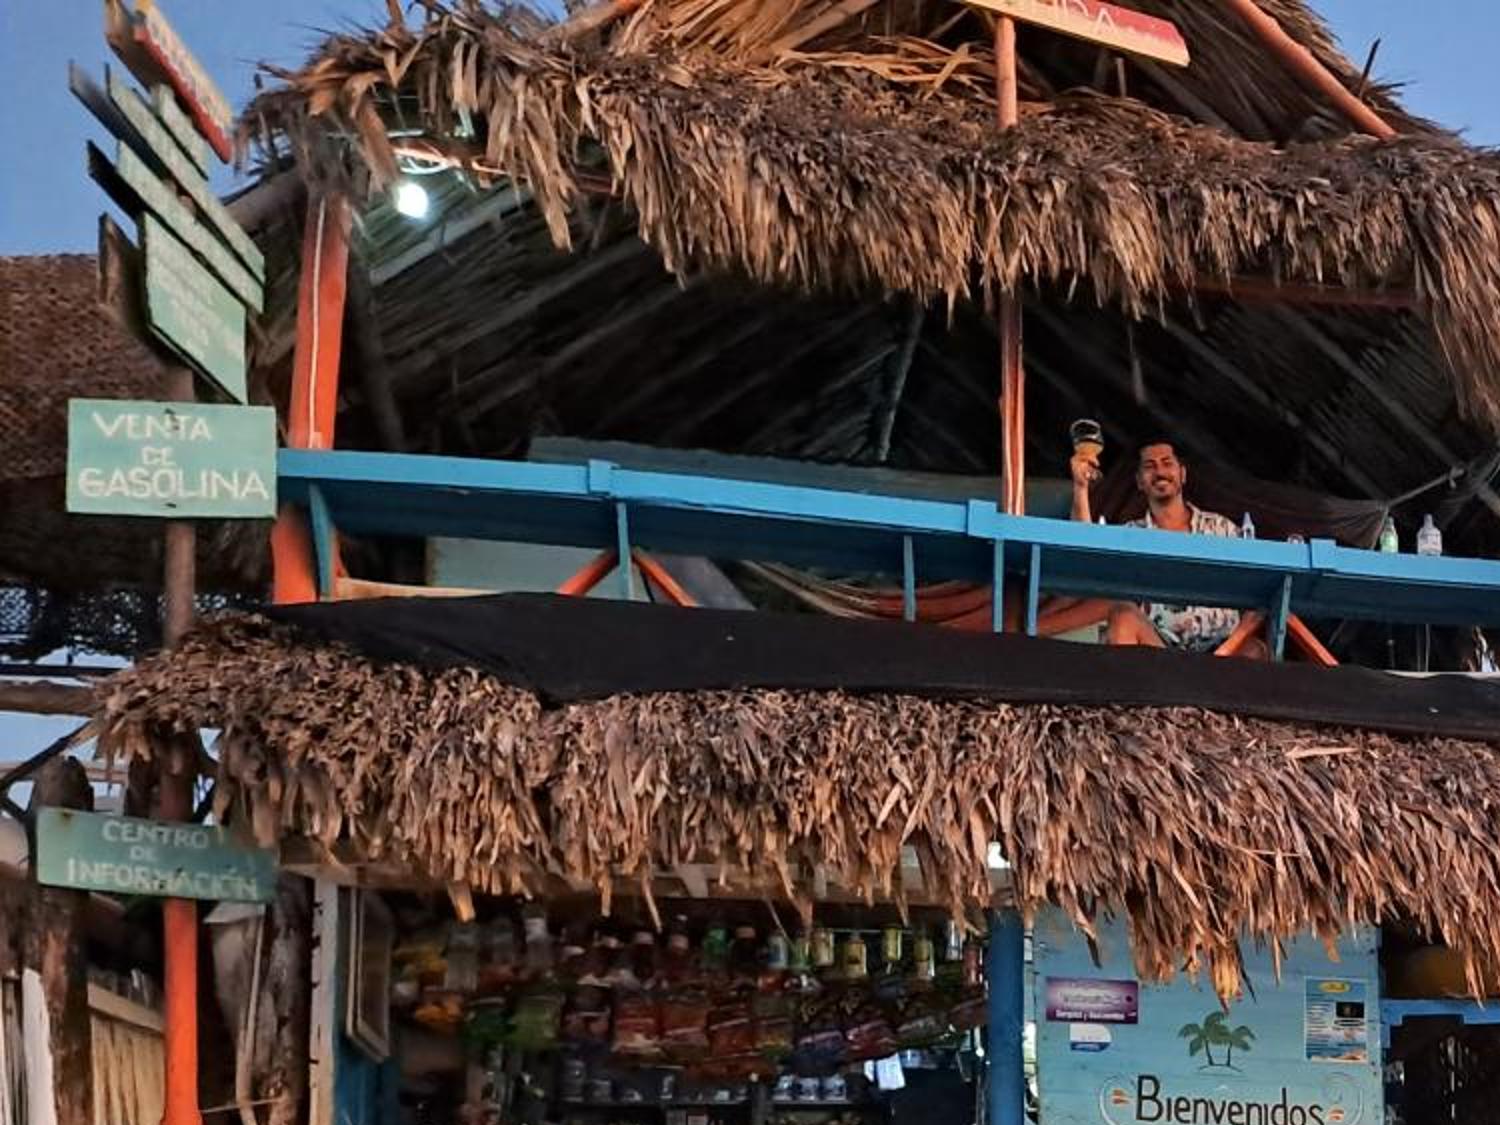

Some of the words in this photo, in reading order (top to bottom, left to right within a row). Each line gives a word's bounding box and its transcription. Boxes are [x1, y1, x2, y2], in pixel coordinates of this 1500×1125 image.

[92, 411, 212, 441] VENTA
[141, 446, 176, 466] DE
[78, 466, 270, 499] GASOLINA
[102, 820, 209, 849] CENTRO
[130, 847, 160, 863] DE
